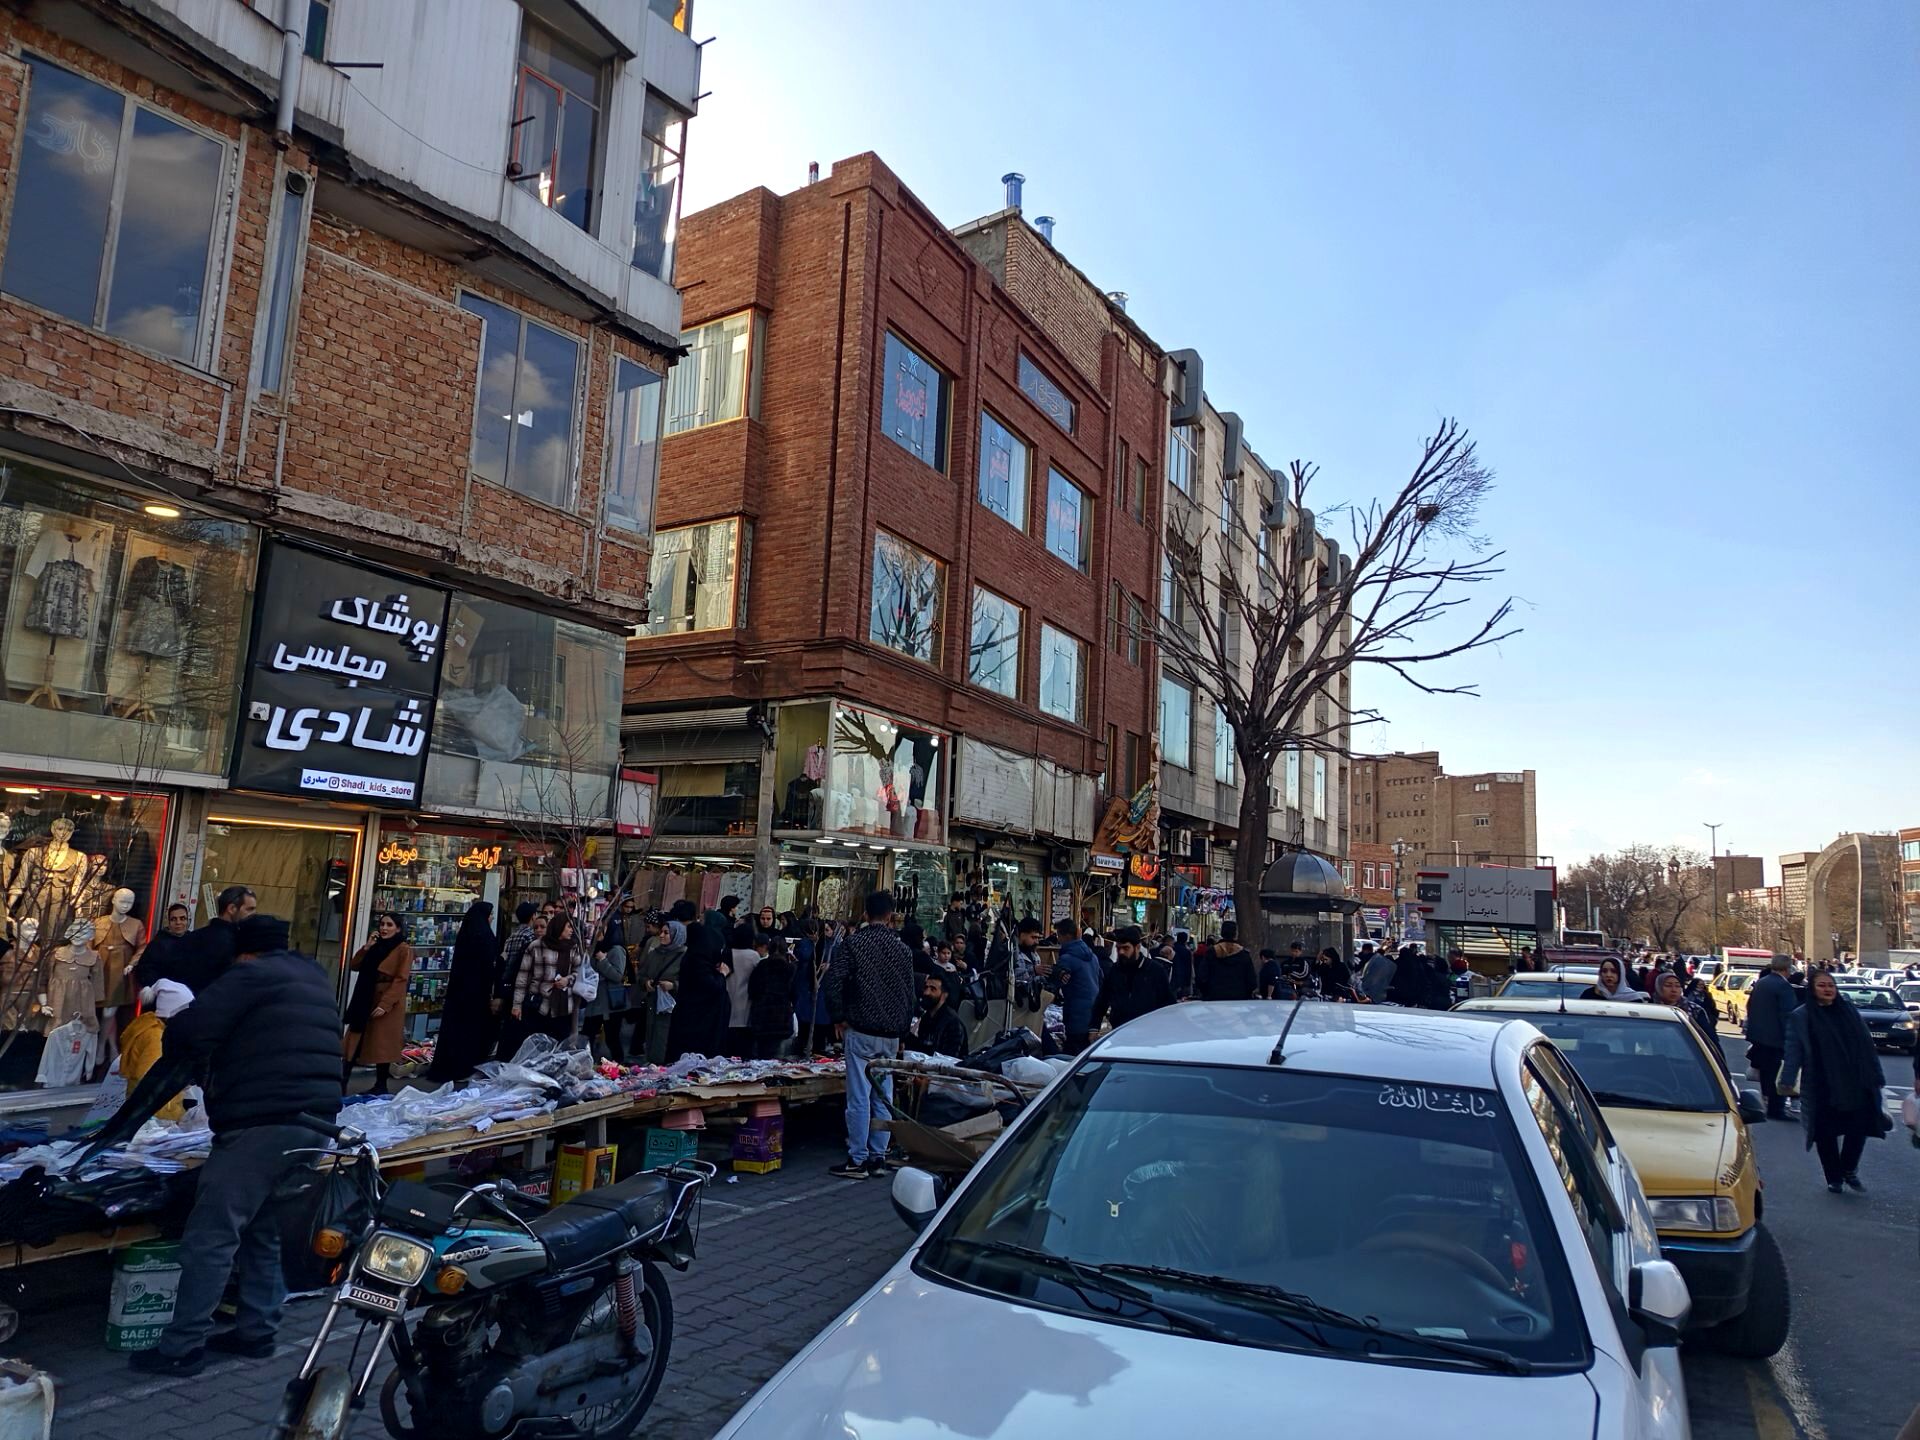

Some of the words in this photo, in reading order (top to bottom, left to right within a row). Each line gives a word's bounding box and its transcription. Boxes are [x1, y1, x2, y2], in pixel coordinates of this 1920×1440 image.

[331, 595, 440, 662] پوشاک
[273, 643, 387, 687] مجلسی
[266, 699, 426, 756] شادی
[303, 775, 328, 785] صدری
[341, 779, 412, 796] Shadi_kids_store
[379, 842, 418, 865] دومان
[458, 846, 502, 869] آرایشی
[1468, 885, 1494, 898] میدان
[352, 1289, 394, 1309] HONDA
[120, 1328, 150, 1340] SAE:
